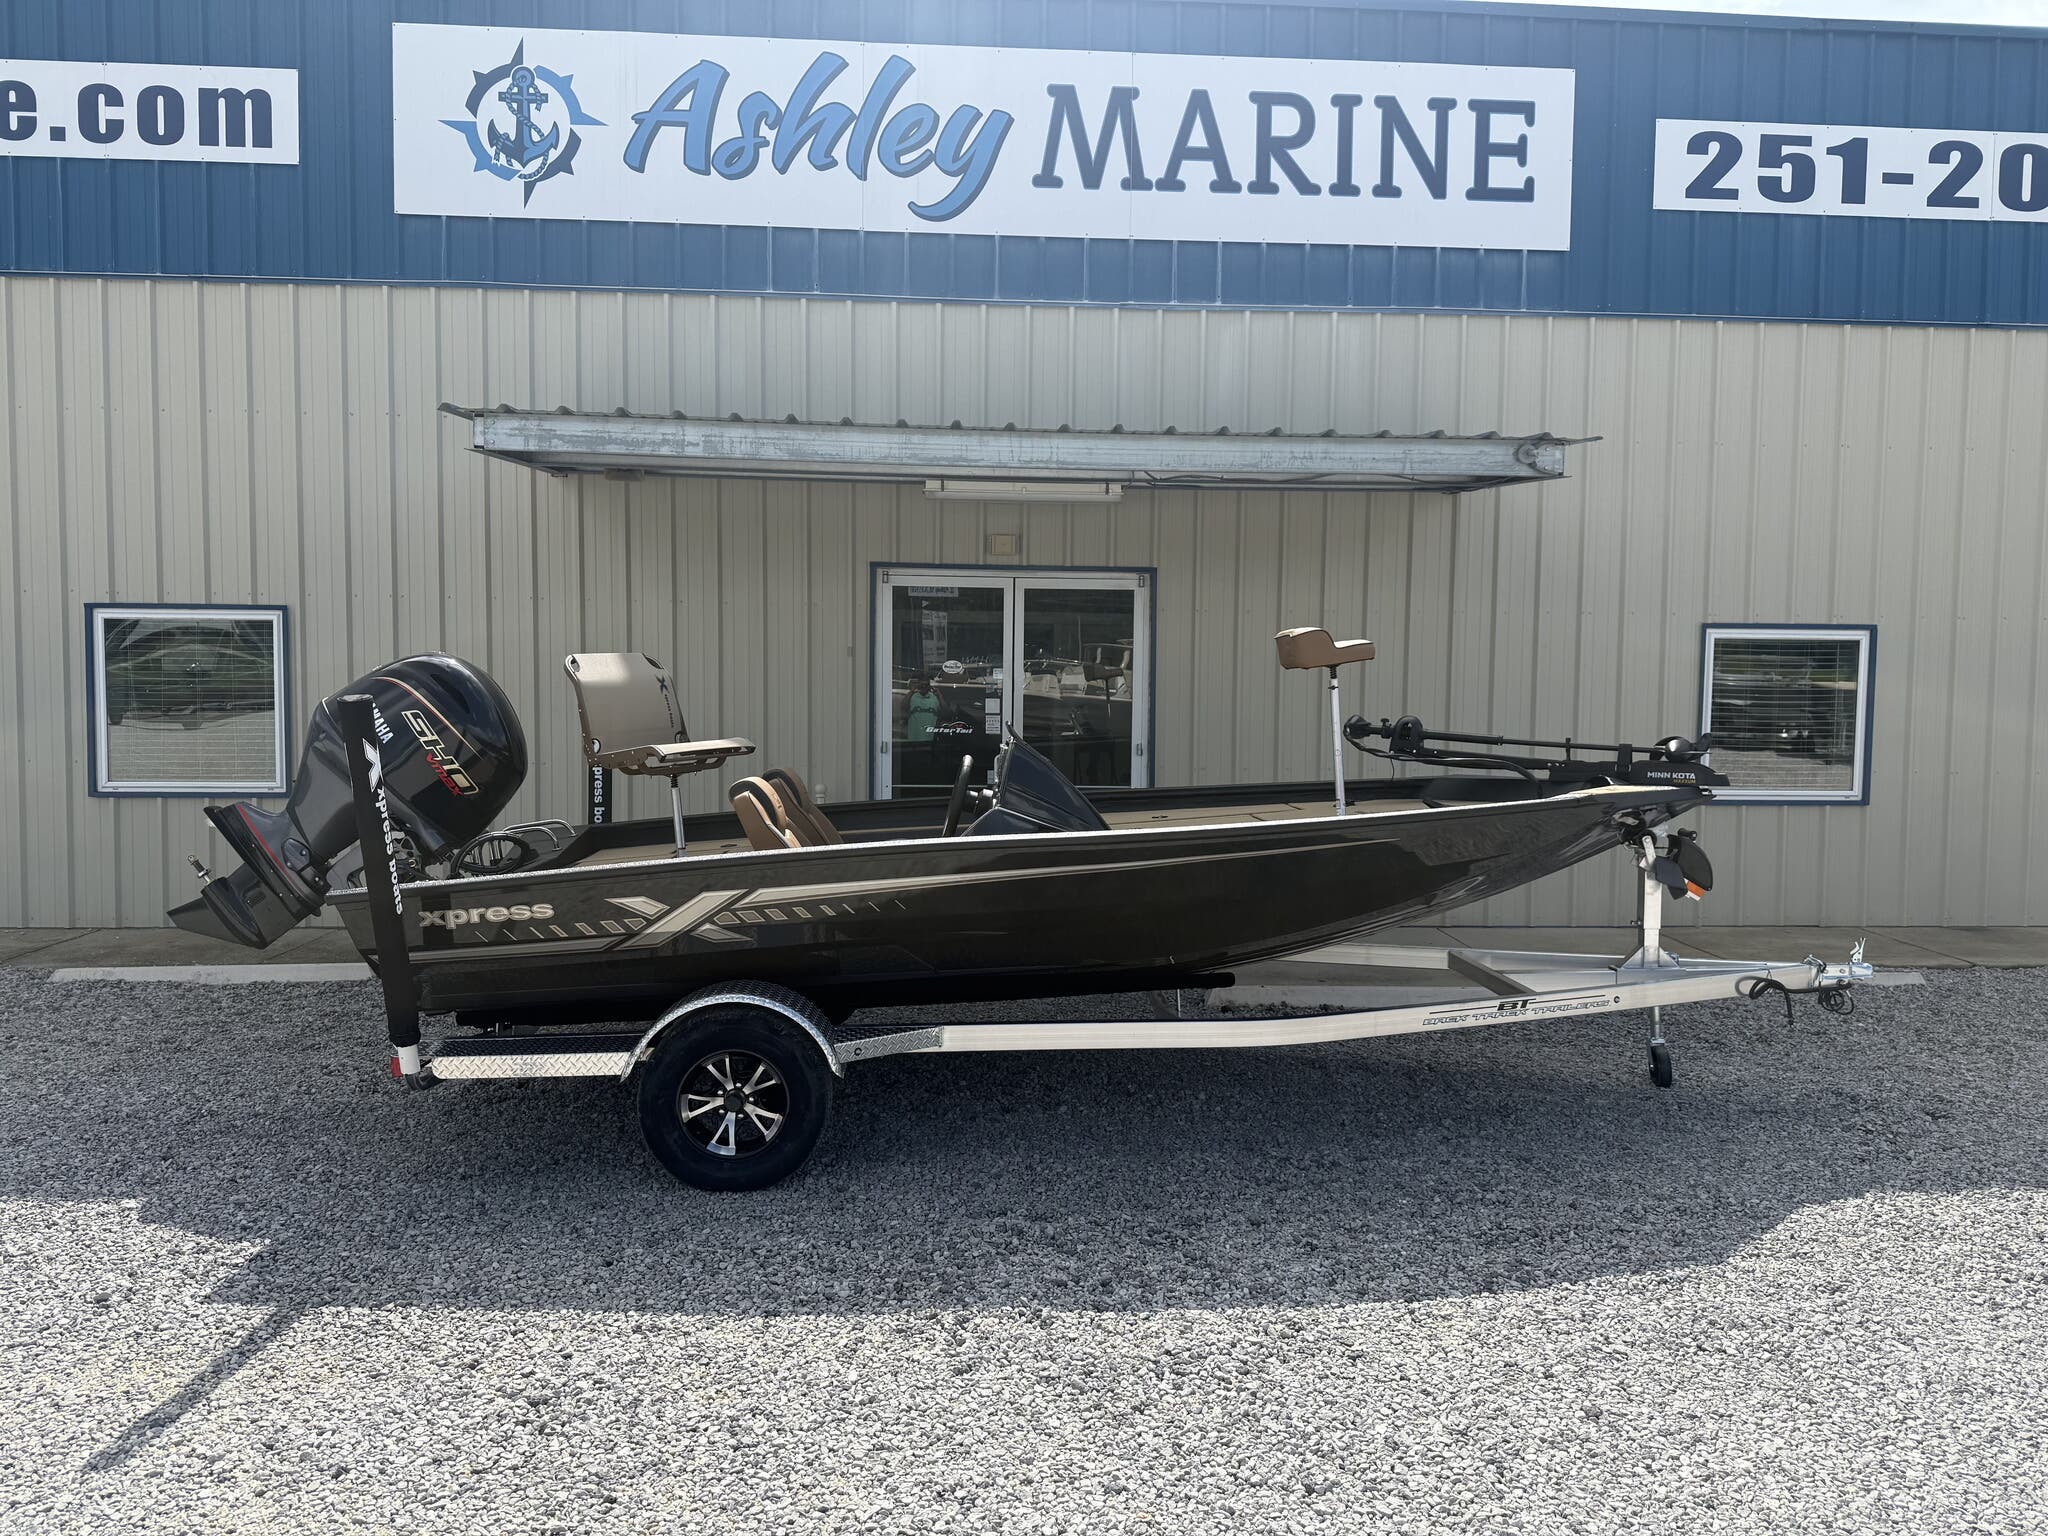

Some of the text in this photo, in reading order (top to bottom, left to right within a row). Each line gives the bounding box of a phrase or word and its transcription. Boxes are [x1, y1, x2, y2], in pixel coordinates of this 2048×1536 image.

[623, 51, 1536, 222] Ashley MARINE
[372, 702, 394, 744] MAHA
[401, 709, 480, 795] SHO
[592, 765, 604, 804] press
[1647, 771, 1696, 780] MINN KOTA
[418, 903, 555, 930] xpress
[1472, 1008, 1530, 1021] TRACK
[1531, 999, 1611, 1015] TRAILERS
[1497, 998, 1537, 1011] BT
